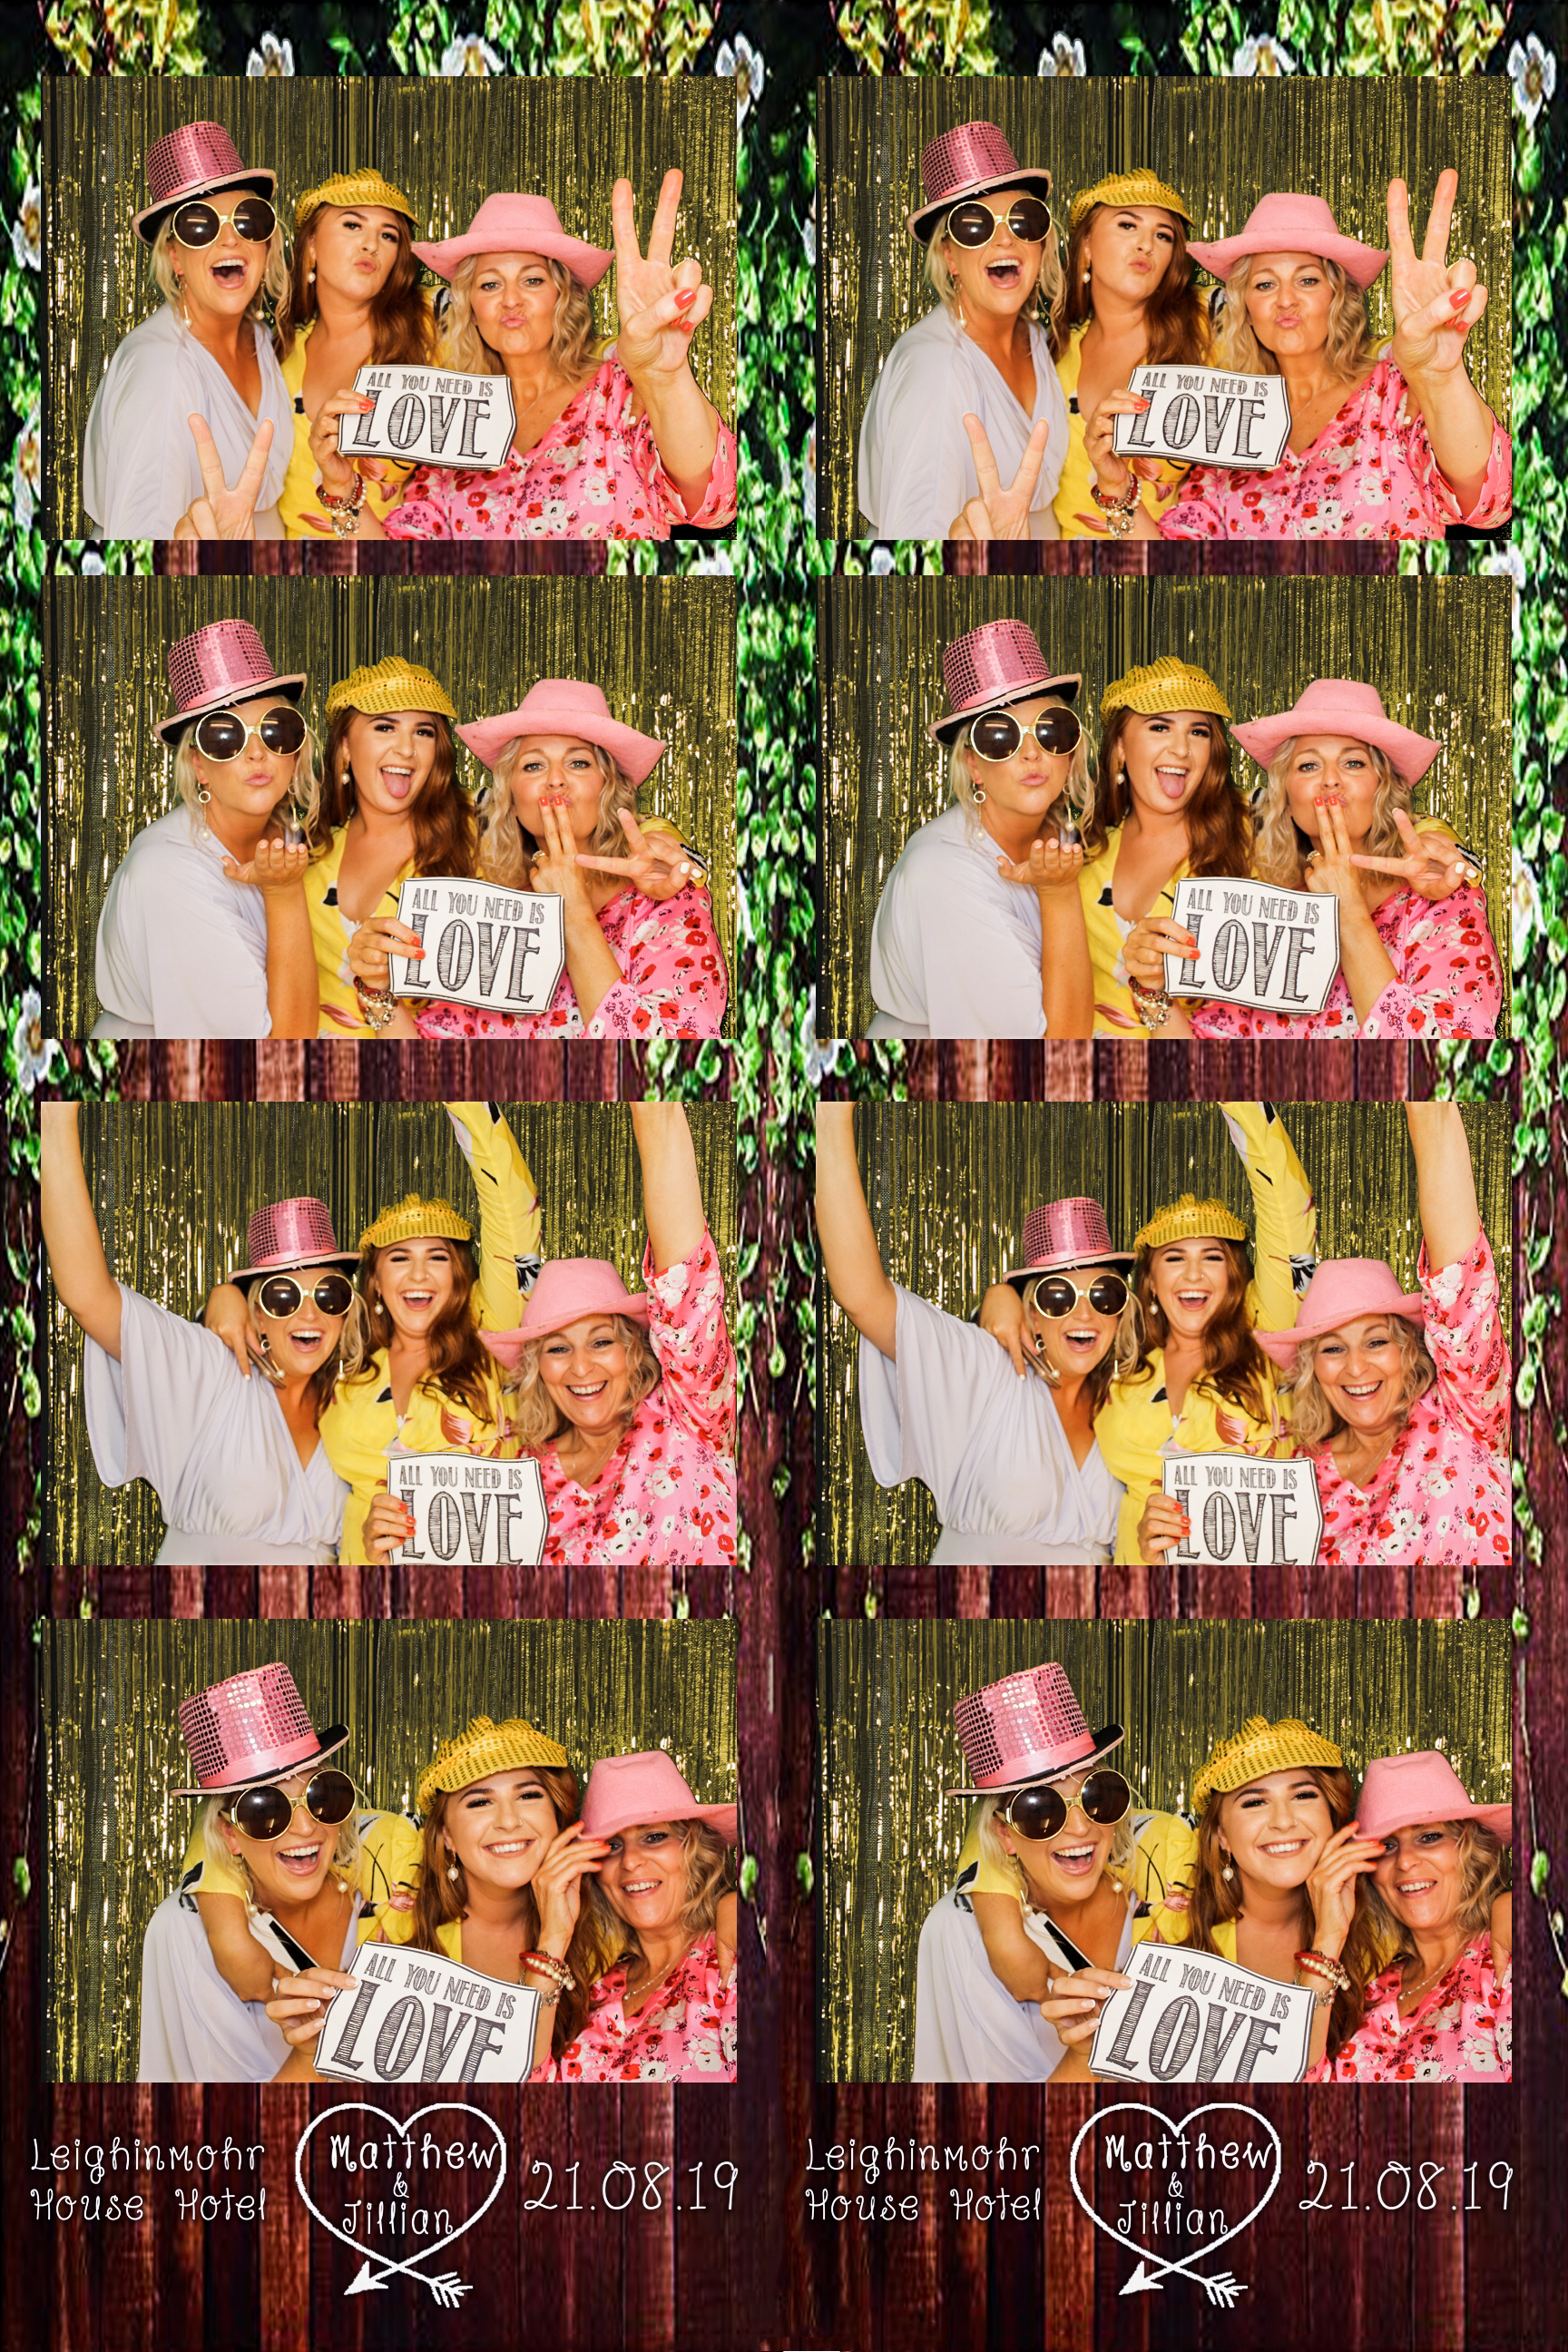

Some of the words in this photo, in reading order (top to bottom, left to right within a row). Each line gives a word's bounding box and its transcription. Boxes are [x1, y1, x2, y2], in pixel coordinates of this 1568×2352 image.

[367, 371, 392, 388] ALL
[401, 374, 430, 391] YOU
[435, 377, 473, 396] NEED
[478, 381, 494, 397] IS
[1142, 371, 1167, 388] ALL
[1176, 374, 1205, 391] YOU
[1210, 377, 1248, 396] NEED
[1253, 381, 1269, 397] IS
[352, 389, 491, 459] LOVE
[1127, 389, 1266, 459] LOVE
[412, 887, 438, 912] ALL
[448, 891, 478, 916] YOU
[484, 896, 524, 922] NEED
[529, 902, 545, 925] IS
[1187, 887, 1213, 912] ALL
[1223, 891, 1253, 916] YOU
[1259, 896, 1298, 922] NEED
[1304, 902, 1320, 925] IS
[404, 913, 541, 1004] LOVE
[1179, 913, 1316, 1004] LOVE
[399, 1465, 423, 1486] ALL
[430, 1465, 458, 1487] YOU
[465, 1466, 502, 1489] NEED
[508, 1468, 524, 1490] IS
[1174, 1465, 1198, 1486] ALL
[1205, 1465, 1233, 1487] YOU
[1240, 1466, 1277, 1489] NEED
[1283, 1468, 1298, 1490] IS
[399, 1489, 524, 1565] LOVE
[1174, 1489, 1298, 1565] LOVE
[364, 1953, 397, 1984] ALL
[404, 1963, 442, 1995] YOU
[443, 1975, 492, 2012] NEED
[495, 1992, 517, 2020] IS
[1139, 1953, 1172, 1984] ALL
[1179, 1963, 1217, 1995] YOU
[1218, 1975, 1267, 2012] NEED
[1269, 1992, 1292, 2020] IS
[330, 1979, 506, 2082] LOVE
[1105, 1979, 1281, 2082] LOVE
